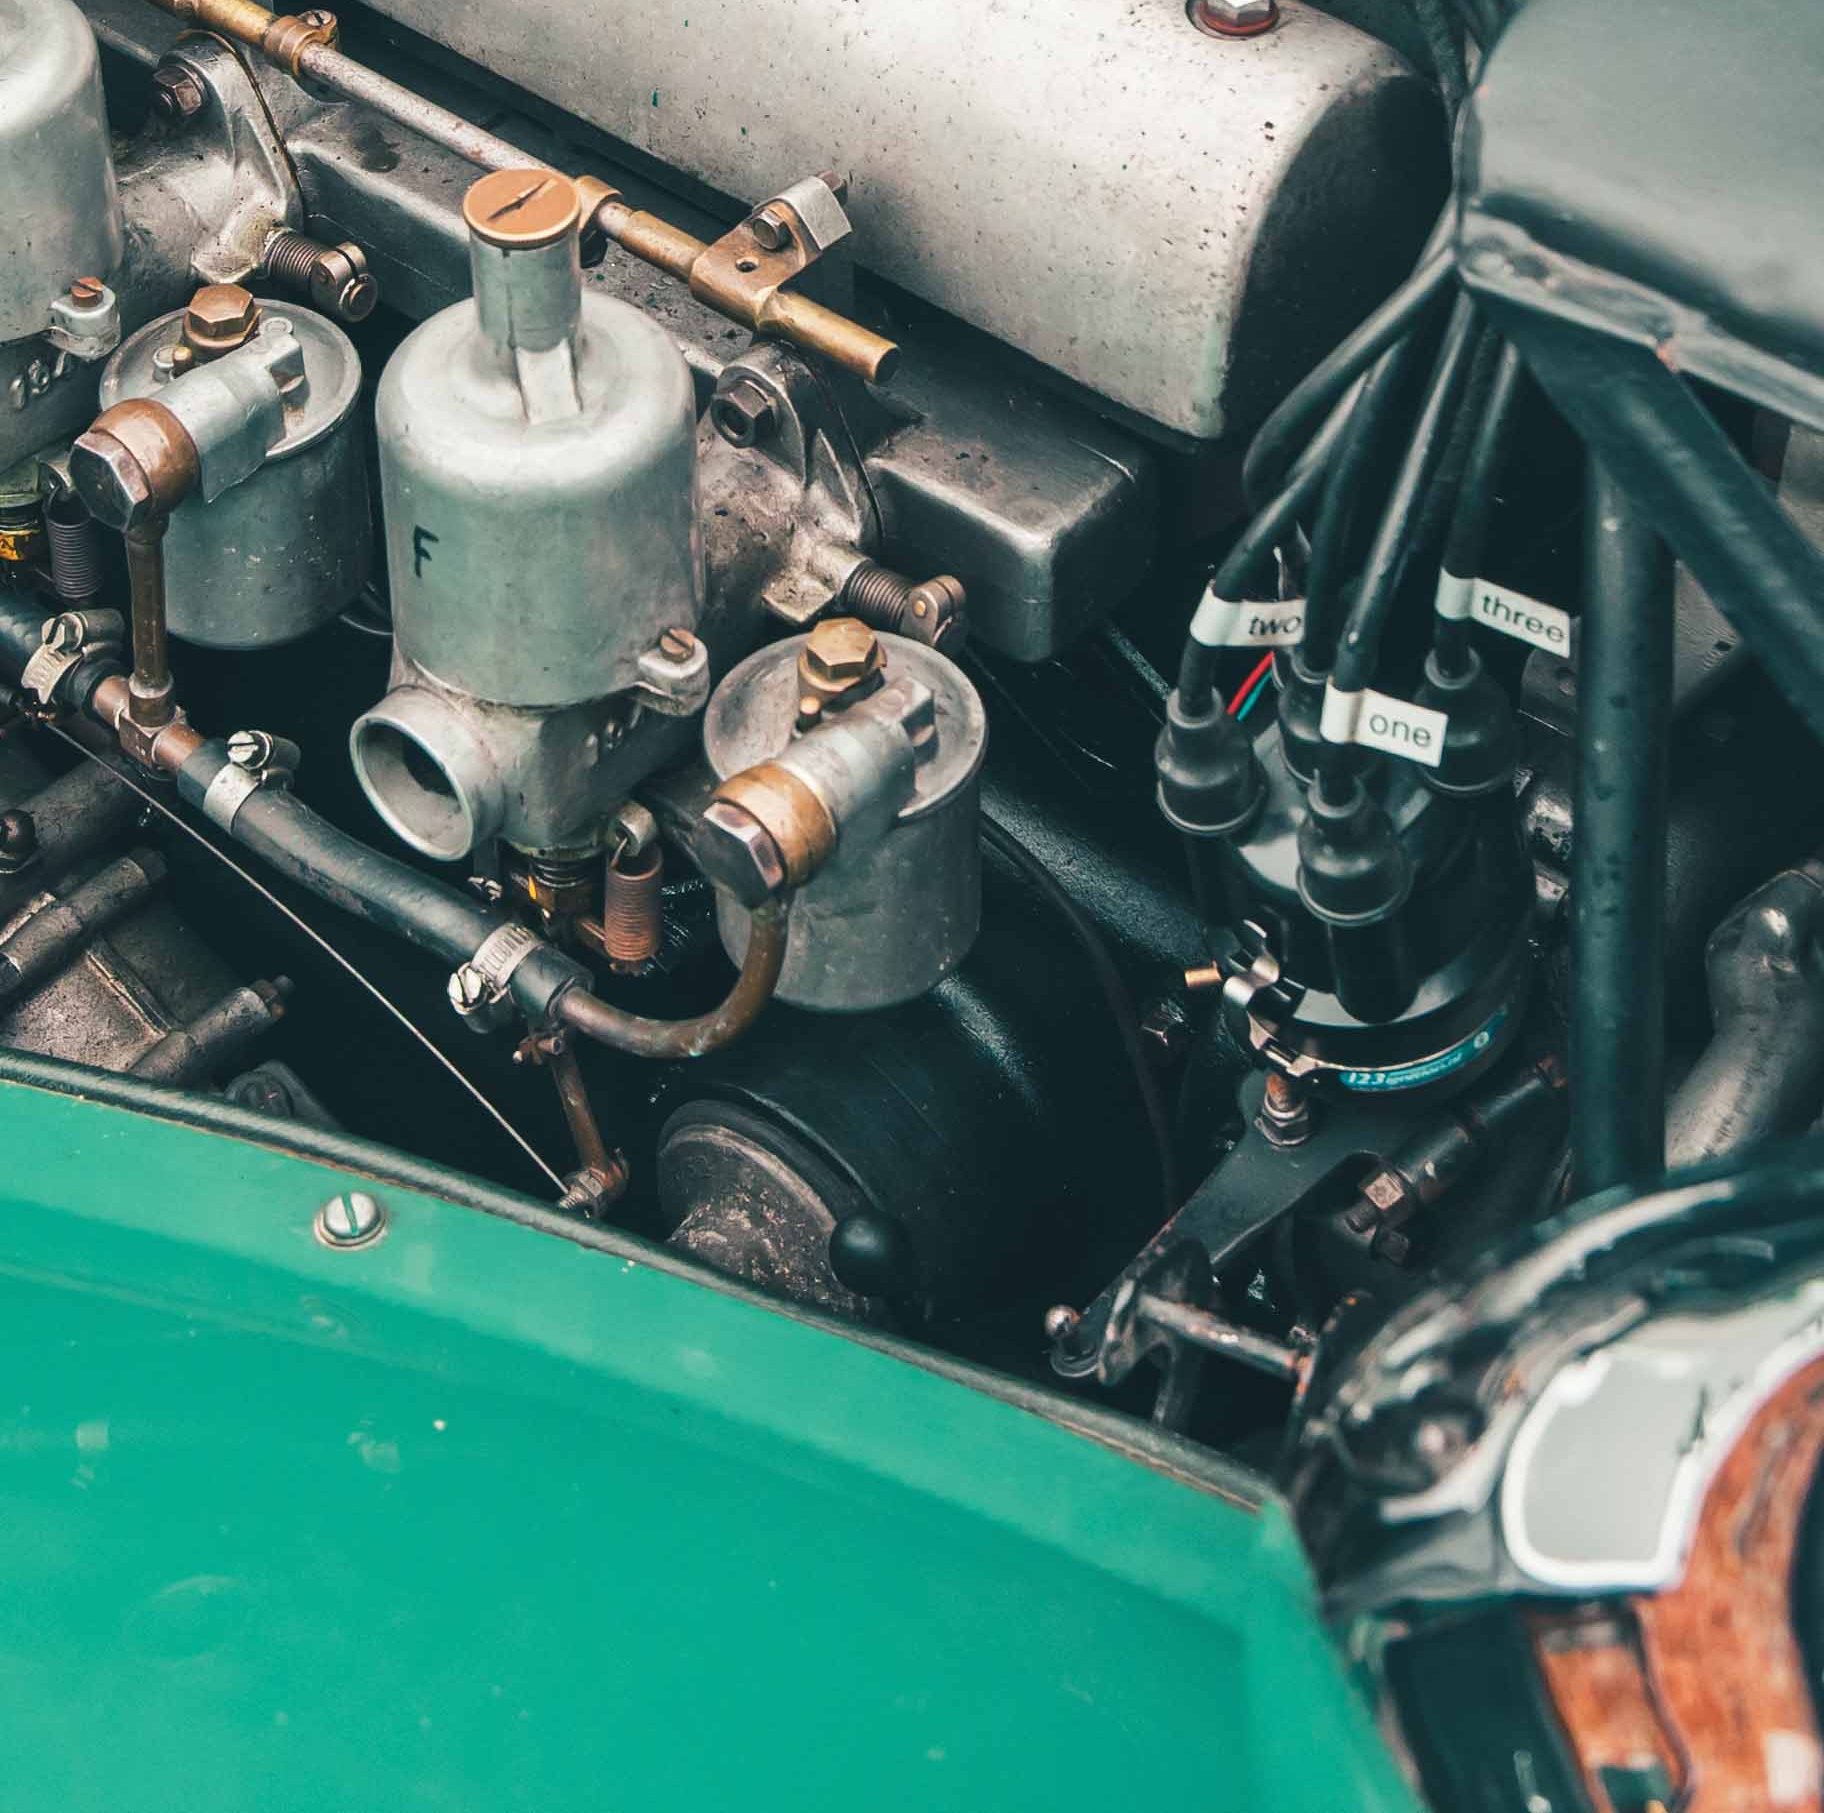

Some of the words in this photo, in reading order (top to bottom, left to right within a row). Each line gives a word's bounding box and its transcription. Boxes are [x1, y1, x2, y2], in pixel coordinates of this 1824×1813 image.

[412, 524, 440, 579] F
[1248, 614, 1302, 637] two
[1482, 592, 1566, 645] three
[1369, 710, 1433, 749] one
[1348, 1071, 1386, 1085] 123
